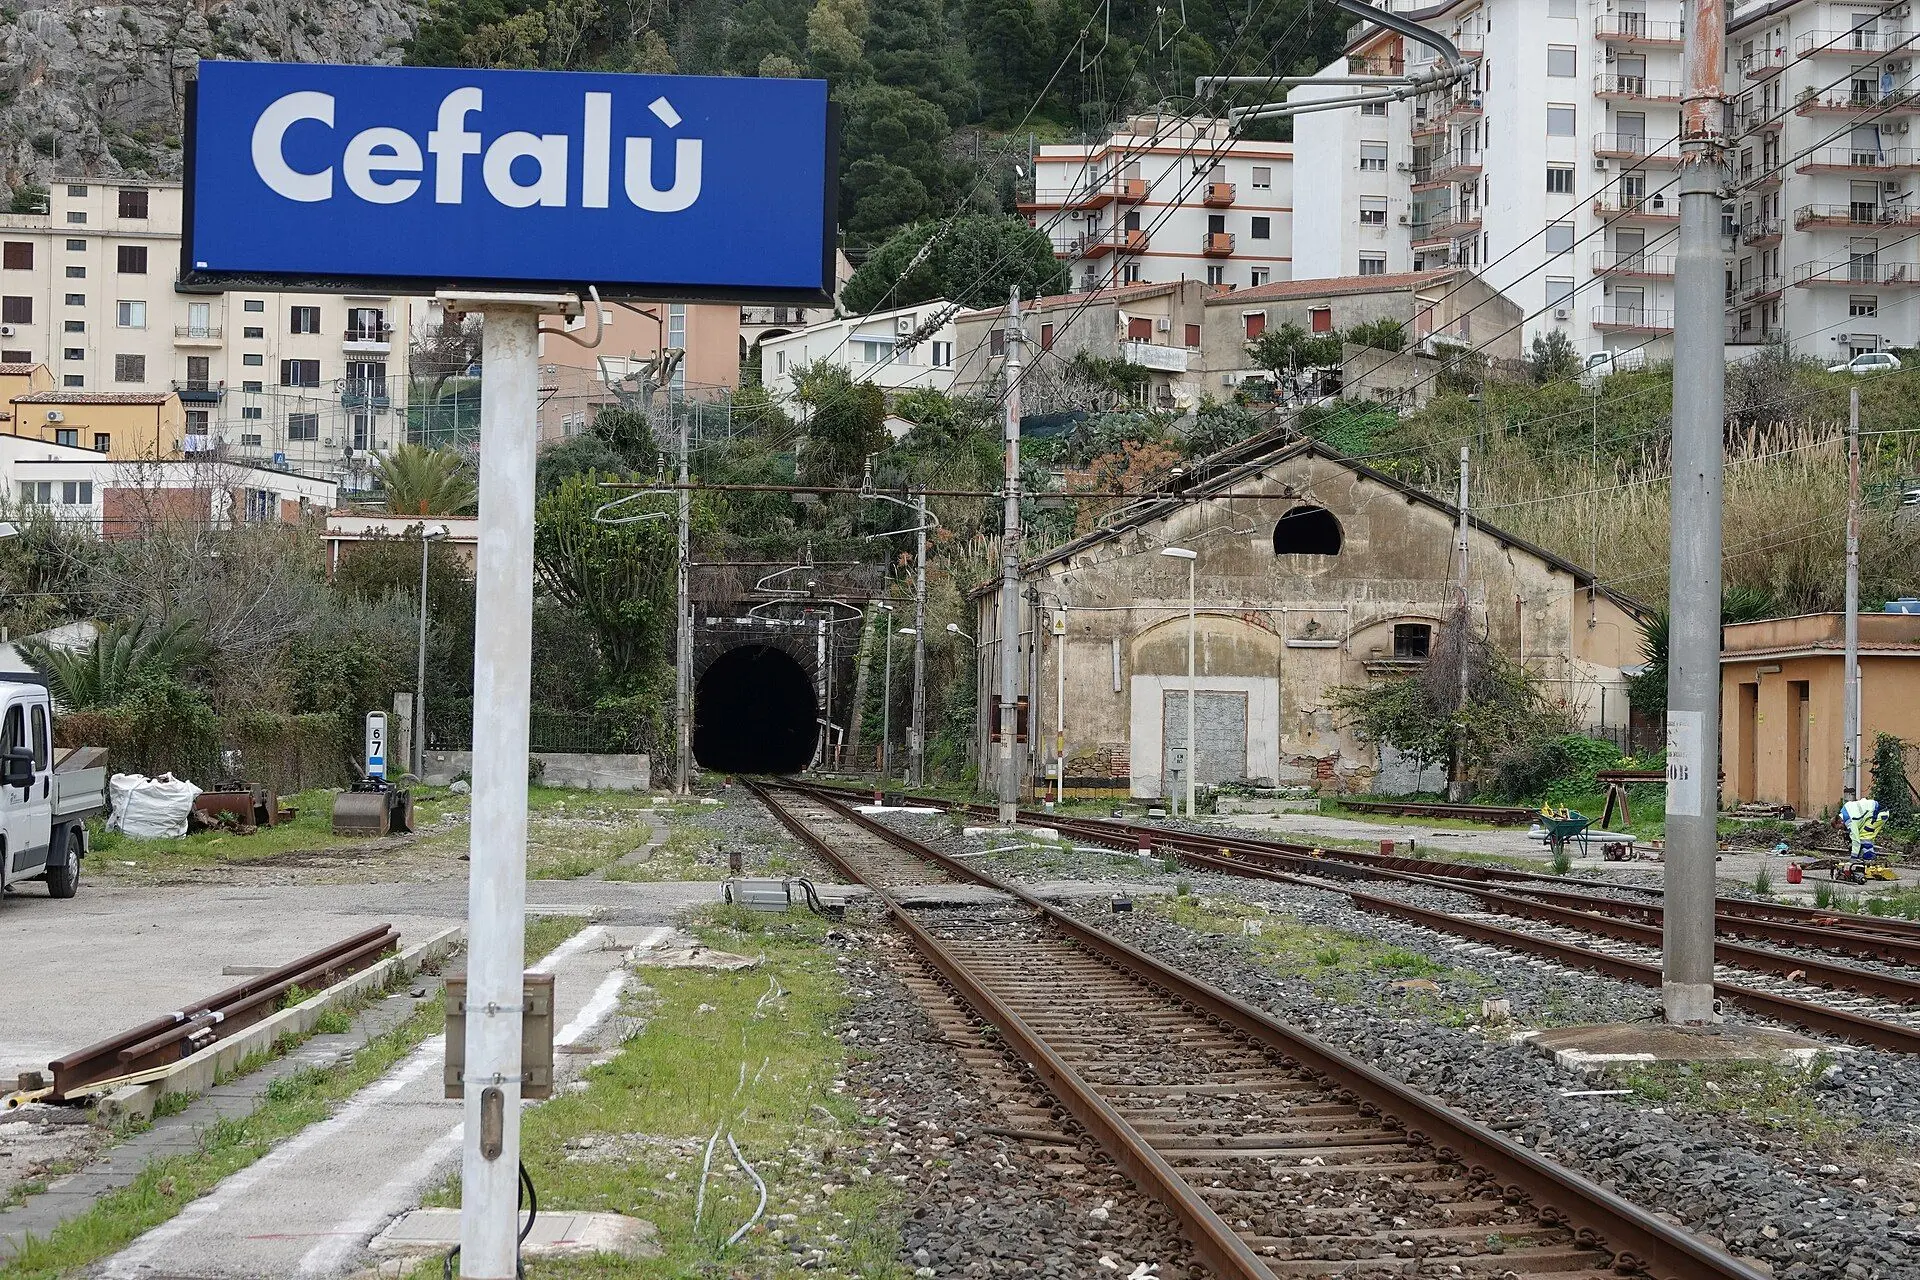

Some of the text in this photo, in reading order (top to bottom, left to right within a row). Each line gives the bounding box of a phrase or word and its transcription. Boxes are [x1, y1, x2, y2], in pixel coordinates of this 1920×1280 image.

[251, 87, 703, 213] Cefalù
[373, 729, 380, 739] 6
[371, 741, 381, 756] 7
